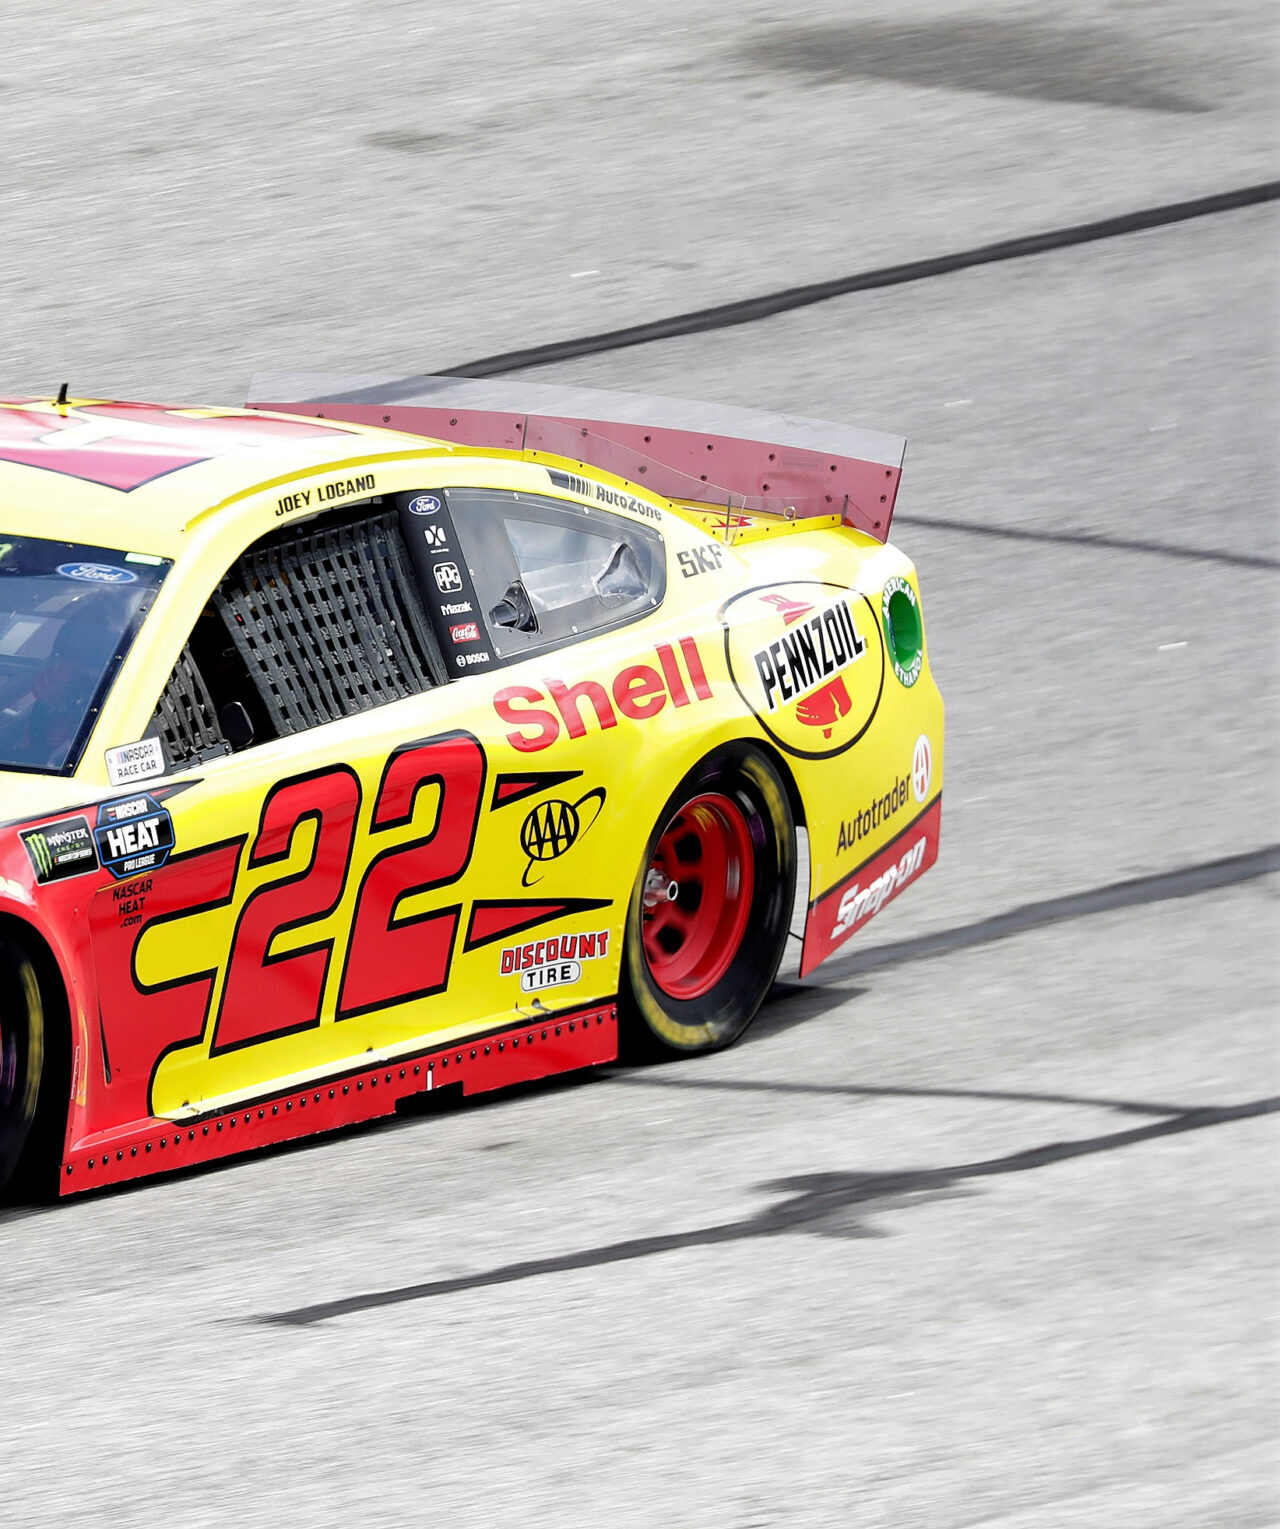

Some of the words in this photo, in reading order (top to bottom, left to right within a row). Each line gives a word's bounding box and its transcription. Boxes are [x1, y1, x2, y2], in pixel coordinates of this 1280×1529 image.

[275, 490, 311, 516] JOEY
[317, 474, 376, 502] LOGANO
[415, 497, 436, 513] Ford
[595, 484, 663, 521] AutoZone
[71, 561, 121, 583] Ford
[436, 566, 461, 590] PPG
[676, 543, 723, 579] SKF
[440, 601, 473, 616] Mazak
[882, 577, 916, 619] AMERICAN
[465, 651, 490, 665] BOSCH
[754, 599, 865, 711] PENNZOIL
[894, 649, 923, 688] ETHANOL
[493, 636, 714, 753] Shell
[117, 764, 139, 779] RACE
[140, 759, 157, 773] CAR
[123, 743, 155, 763] NASCAR
[115, 798, 149, 820] NASCAR
[836, 771, 912, 857] Autotrader
[106, 817, 160, 858] HEAT
[524, 801, 575, 860] AAA
[113, 878, 153, 901] NASCAR
[210, 728, 488, 1059] 22
[831, 836, 927, 940] Snap-on
[118, 896, 146, 917] HEAT
[120, 914, 143, 929] .com
[500, 931, 609, 974] DISCOUNT
[526, 964, 572, 988] TIRE
